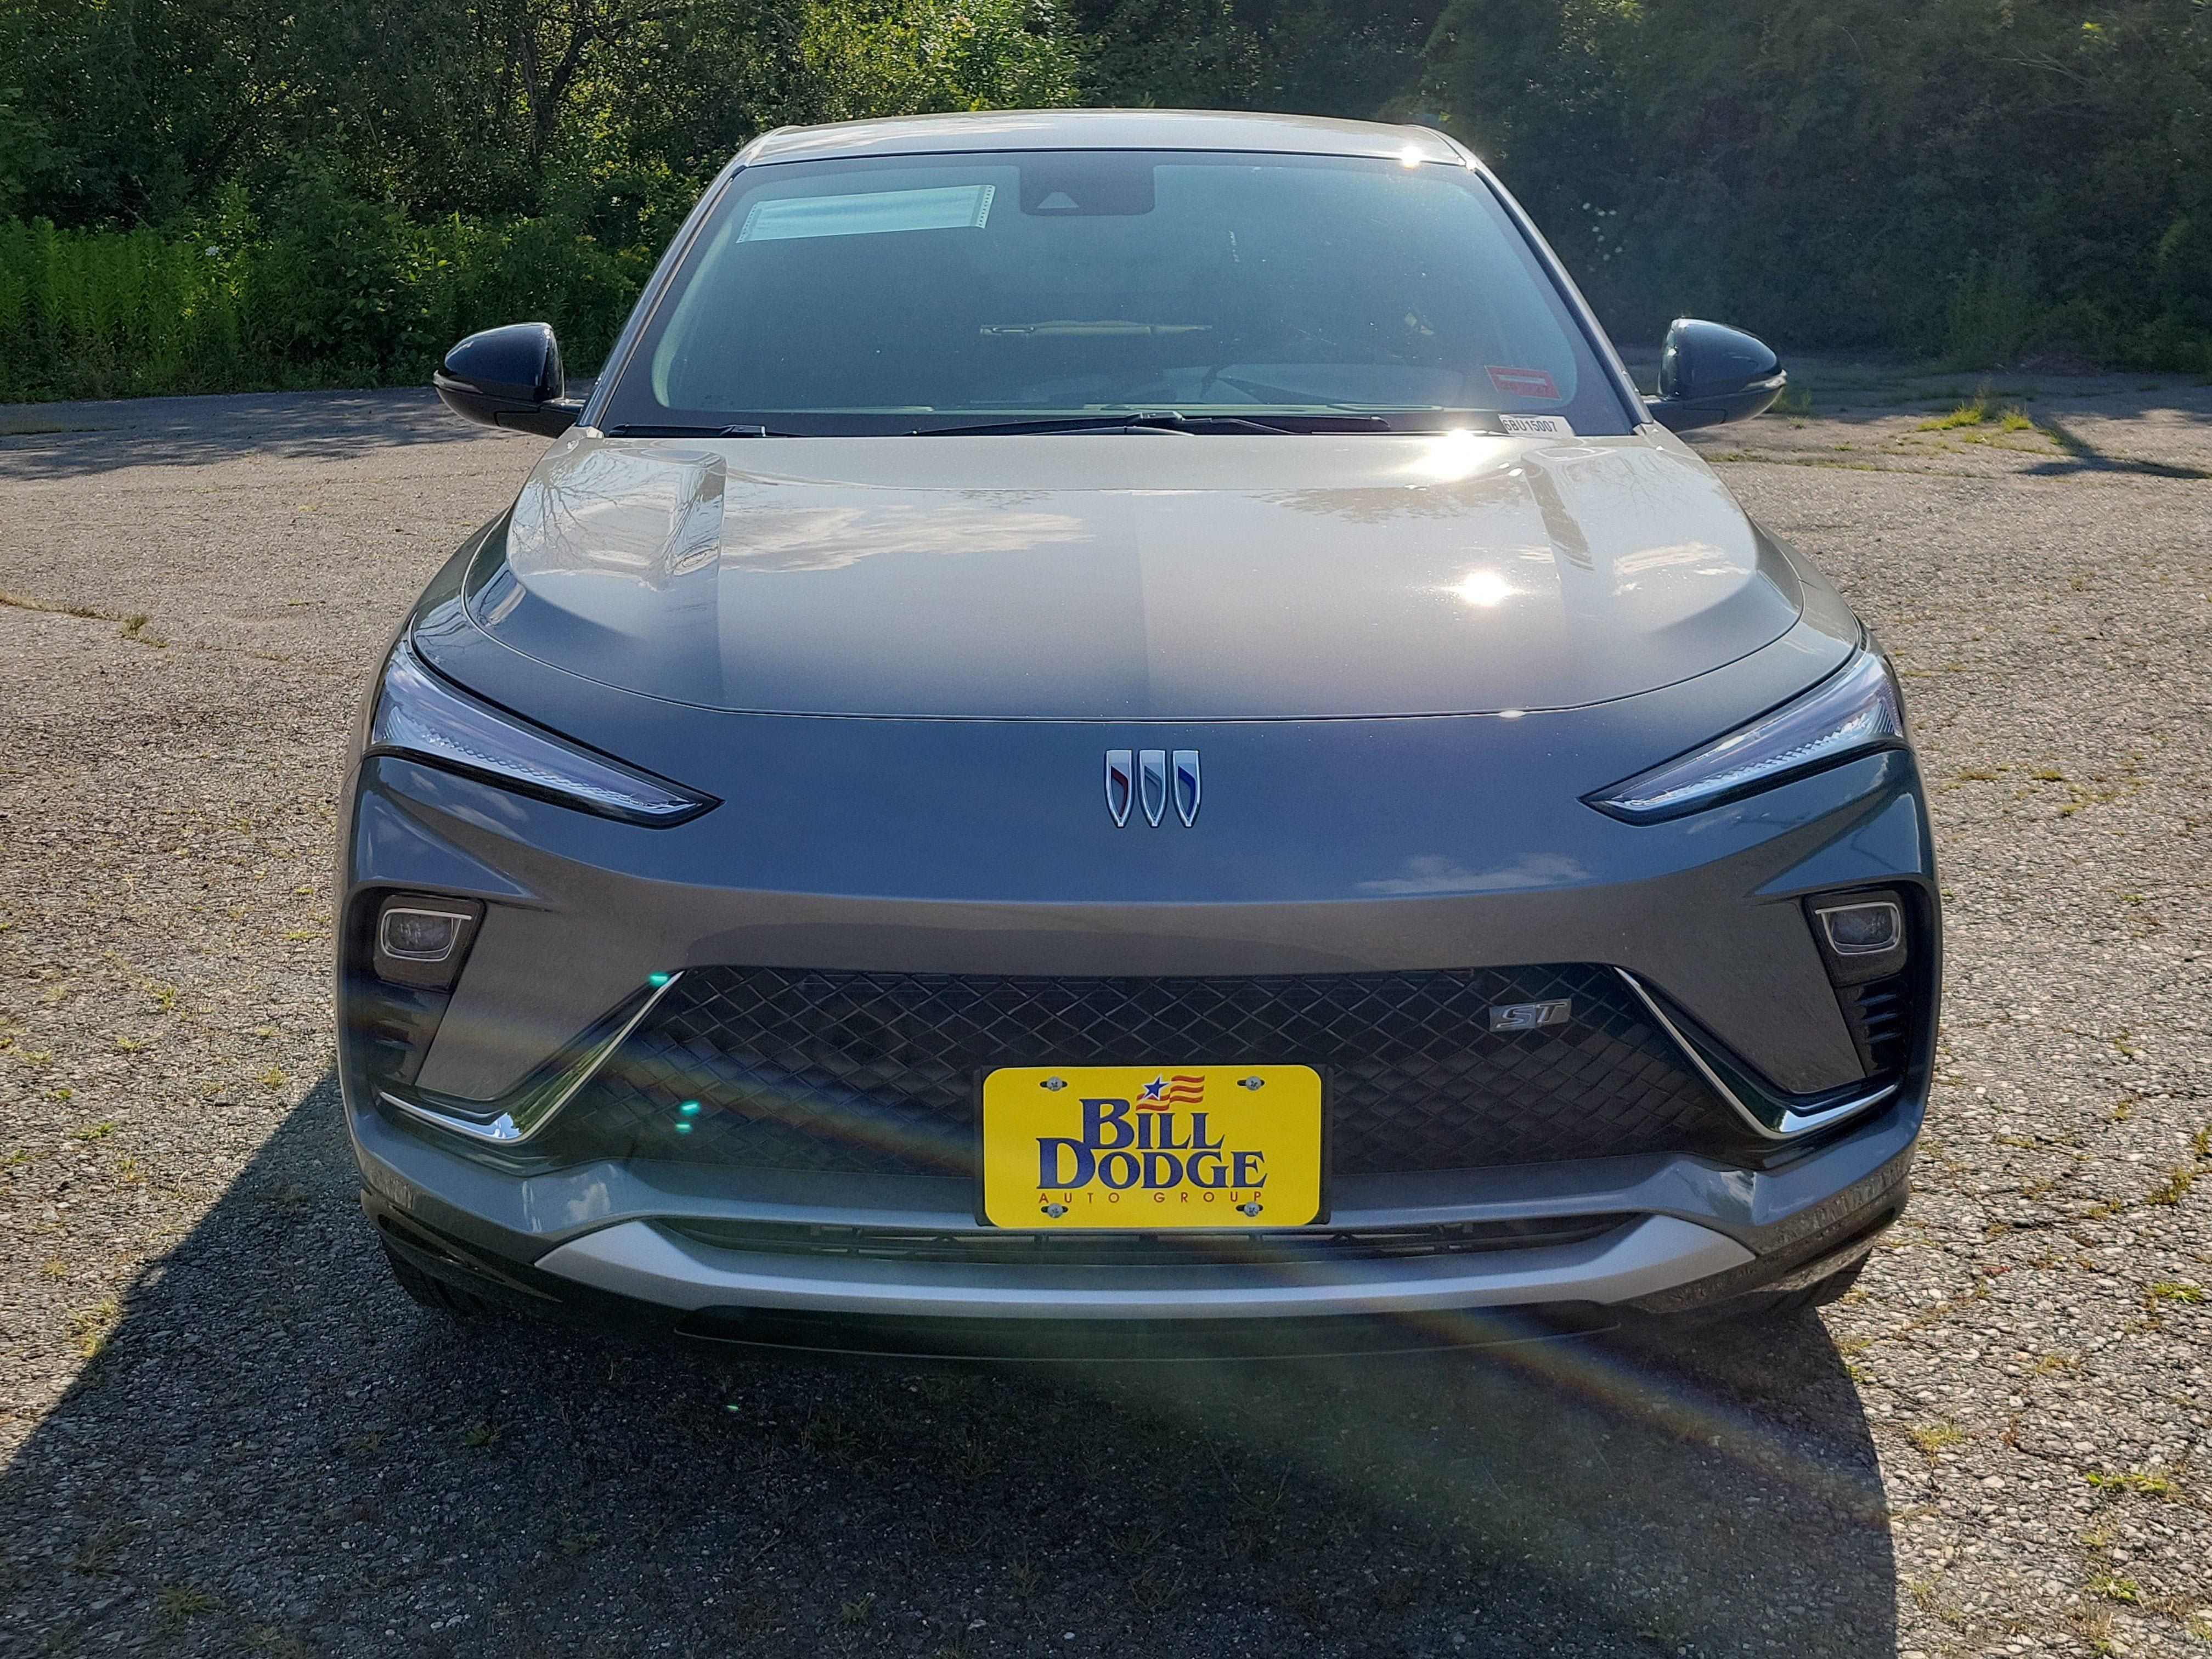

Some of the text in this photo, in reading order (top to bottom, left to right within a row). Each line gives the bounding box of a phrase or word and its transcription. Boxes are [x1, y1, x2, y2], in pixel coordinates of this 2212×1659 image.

[1496, 1002, 1567, 1029] ST
[1079, 1098, 1225, 1150] BILL
[1036, 1137, 1268, 1189] DODGE
[1037, 1191, 1262, 1204] AUTO GROUP
